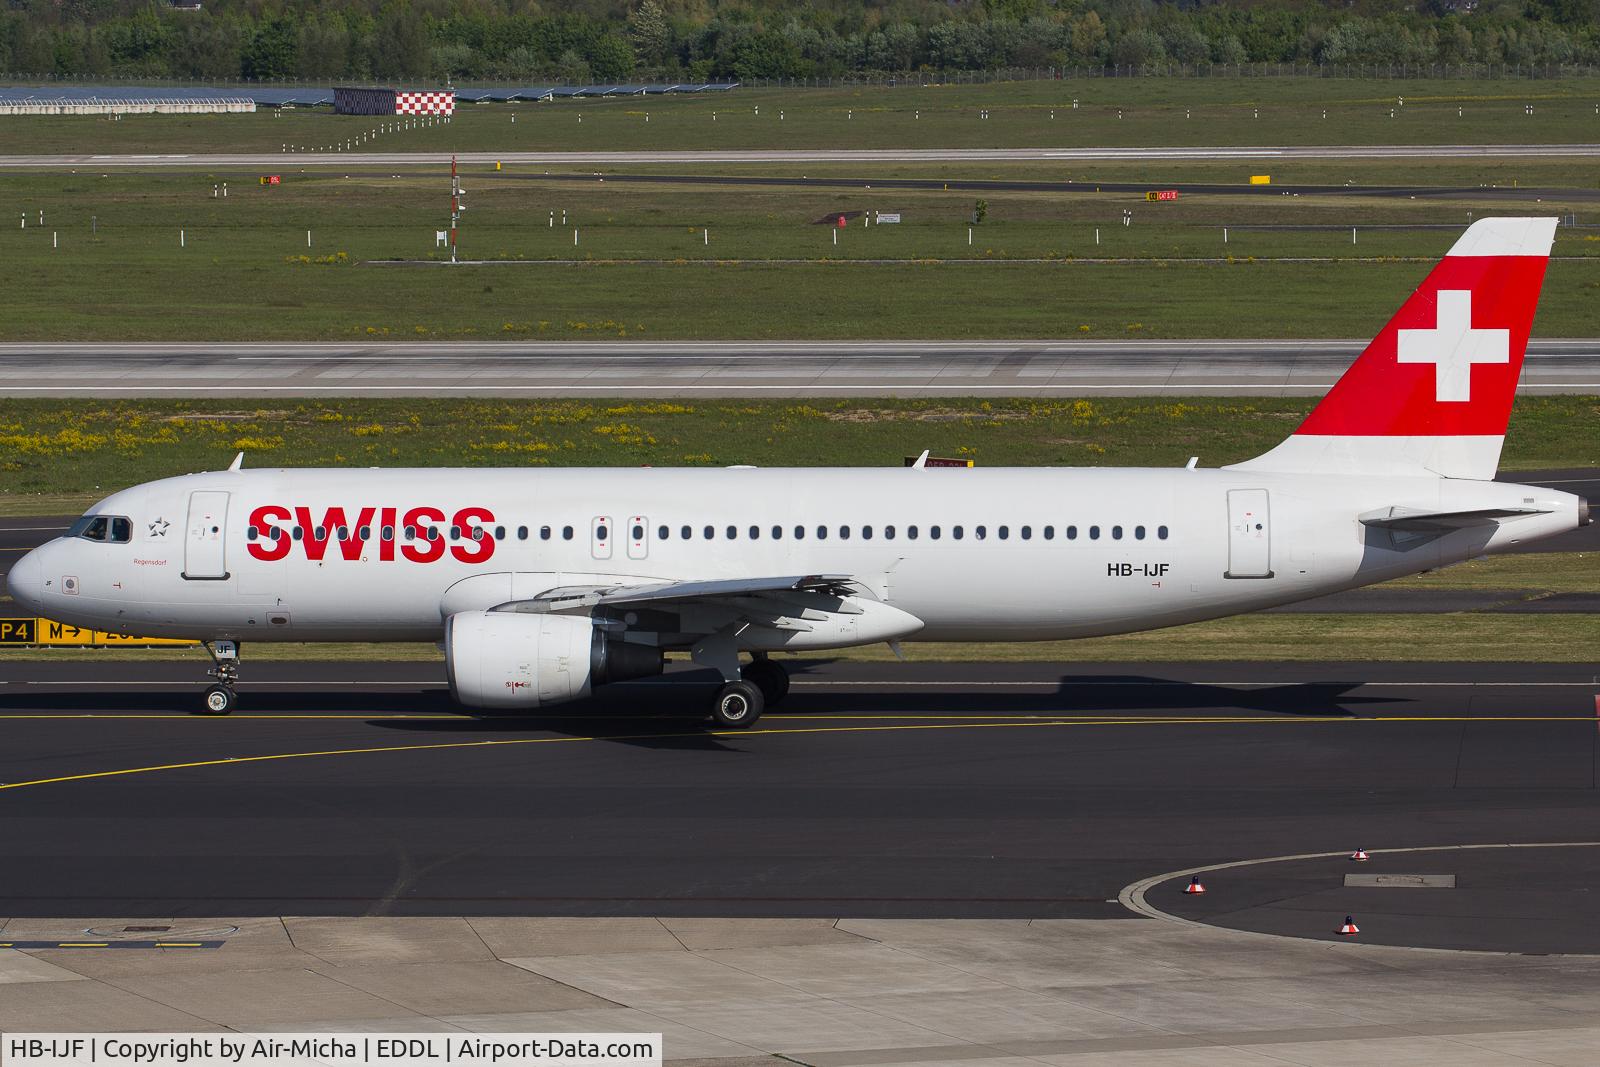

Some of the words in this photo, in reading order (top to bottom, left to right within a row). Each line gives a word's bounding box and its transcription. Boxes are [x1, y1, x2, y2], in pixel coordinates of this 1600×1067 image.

[247, 505, 496, 564] SWISS
[133, 558, 167, 566] Regensdorf
[1107, 563, 1170, 577] HB-IJF
[1, 623, 28, 640] P4
[50, 623, 63, 638] M
[217, 644, 231, 654] JF
